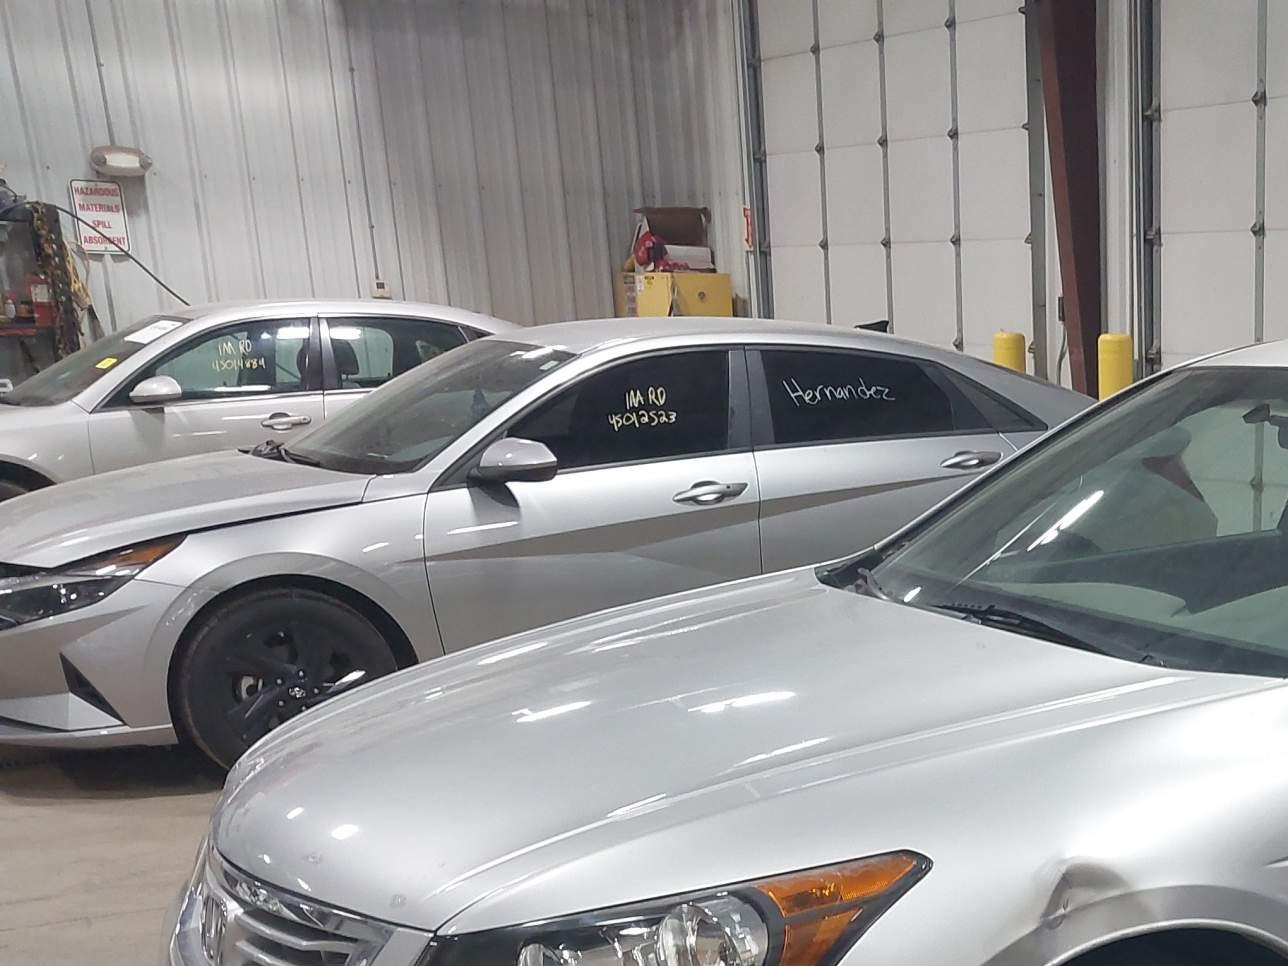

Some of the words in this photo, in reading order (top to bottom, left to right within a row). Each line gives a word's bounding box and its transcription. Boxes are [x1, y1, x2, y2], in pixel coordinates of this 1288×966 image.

[74, 186, 119, 197] HAZARDOUS
[78, 203, 120, 213] MATERIALS
[92, 220, 112, 229] SPILL
[782, 378, 896, 407] Hernandez
[608, 410, 677, 432] 45012523
